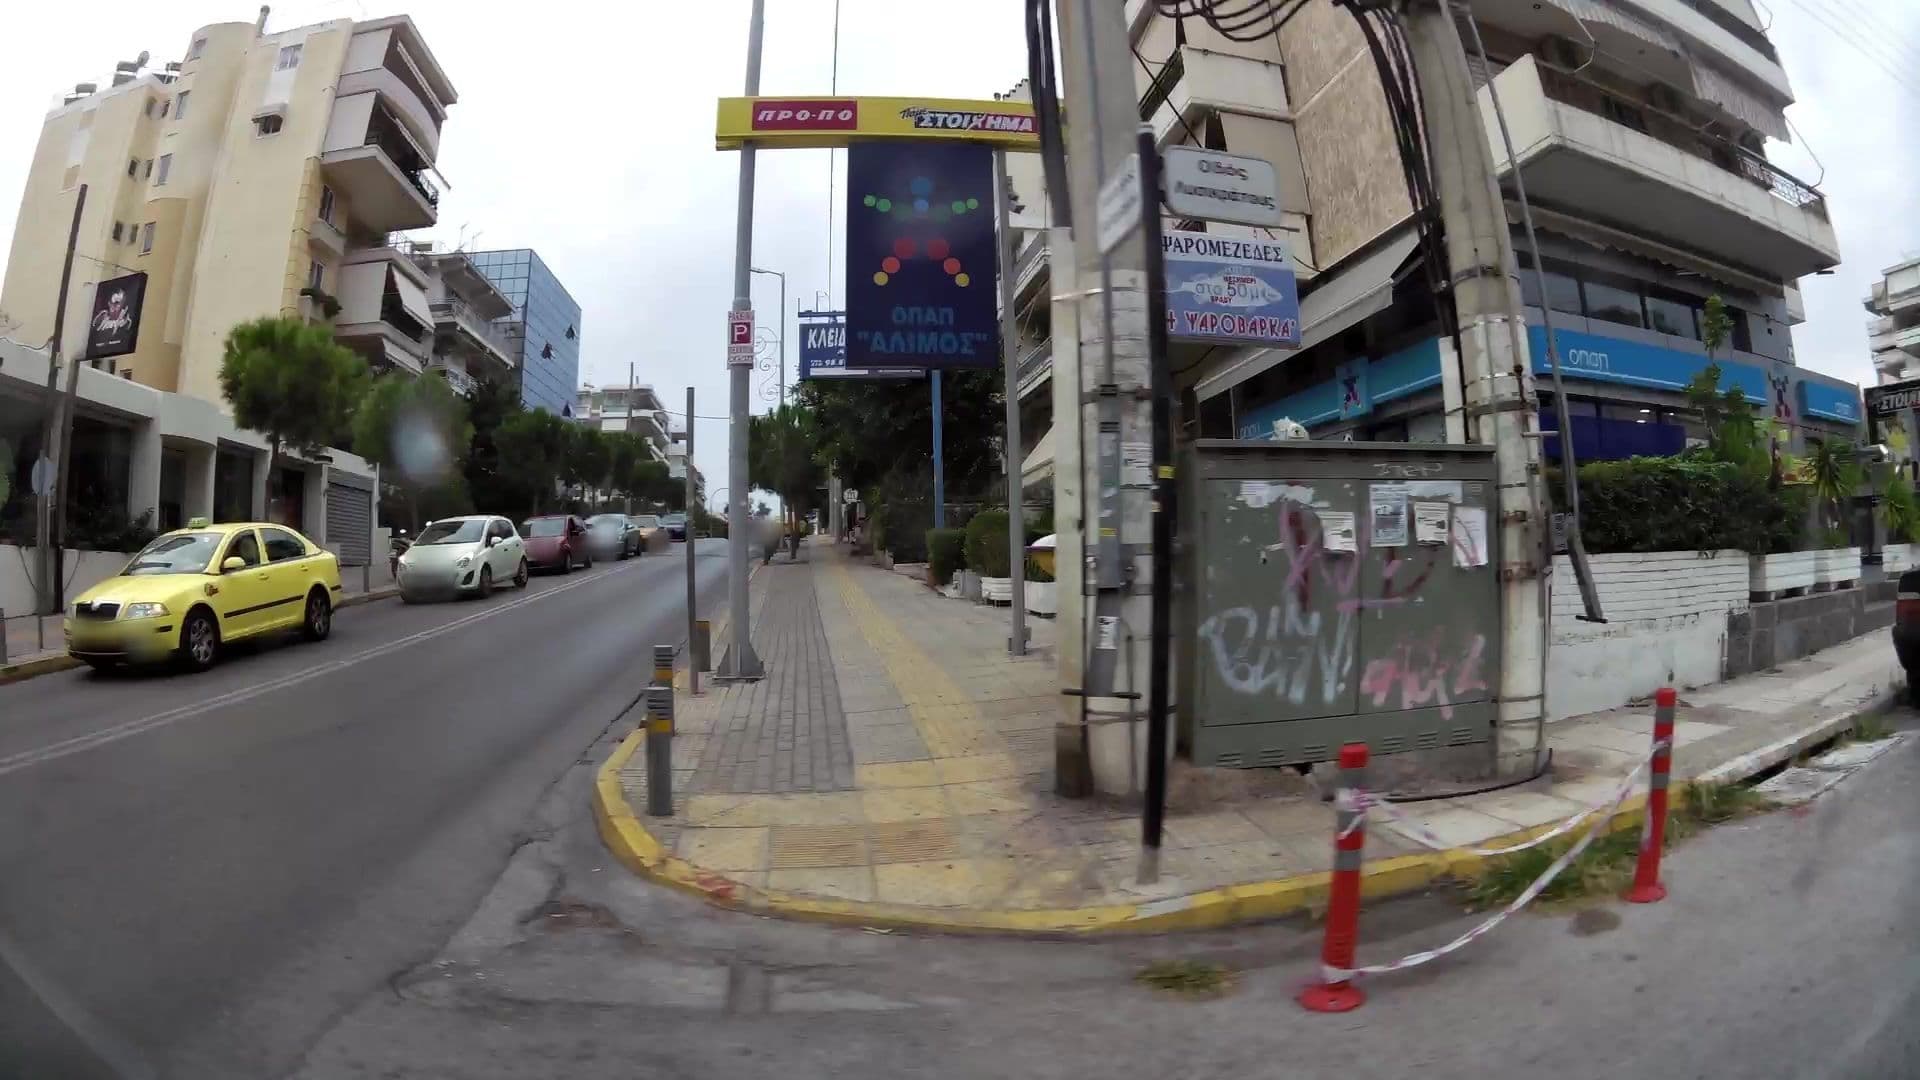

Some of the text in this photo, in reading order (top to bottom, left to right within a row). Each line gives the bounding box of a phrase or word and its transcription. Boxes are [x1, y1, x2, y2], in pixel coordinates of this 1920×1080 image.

[758, 109, 853, 121] ΠΡΟ-ΠΟ
[919, 112, 1033, 131] ΣΤΟΙΧΗΜΑ
[1161, 235, 1283, 262] ΨΑΡΟΜΕΖΕΔΕΣ
[892, 305, 954, 325] ΟΠΑΠ
